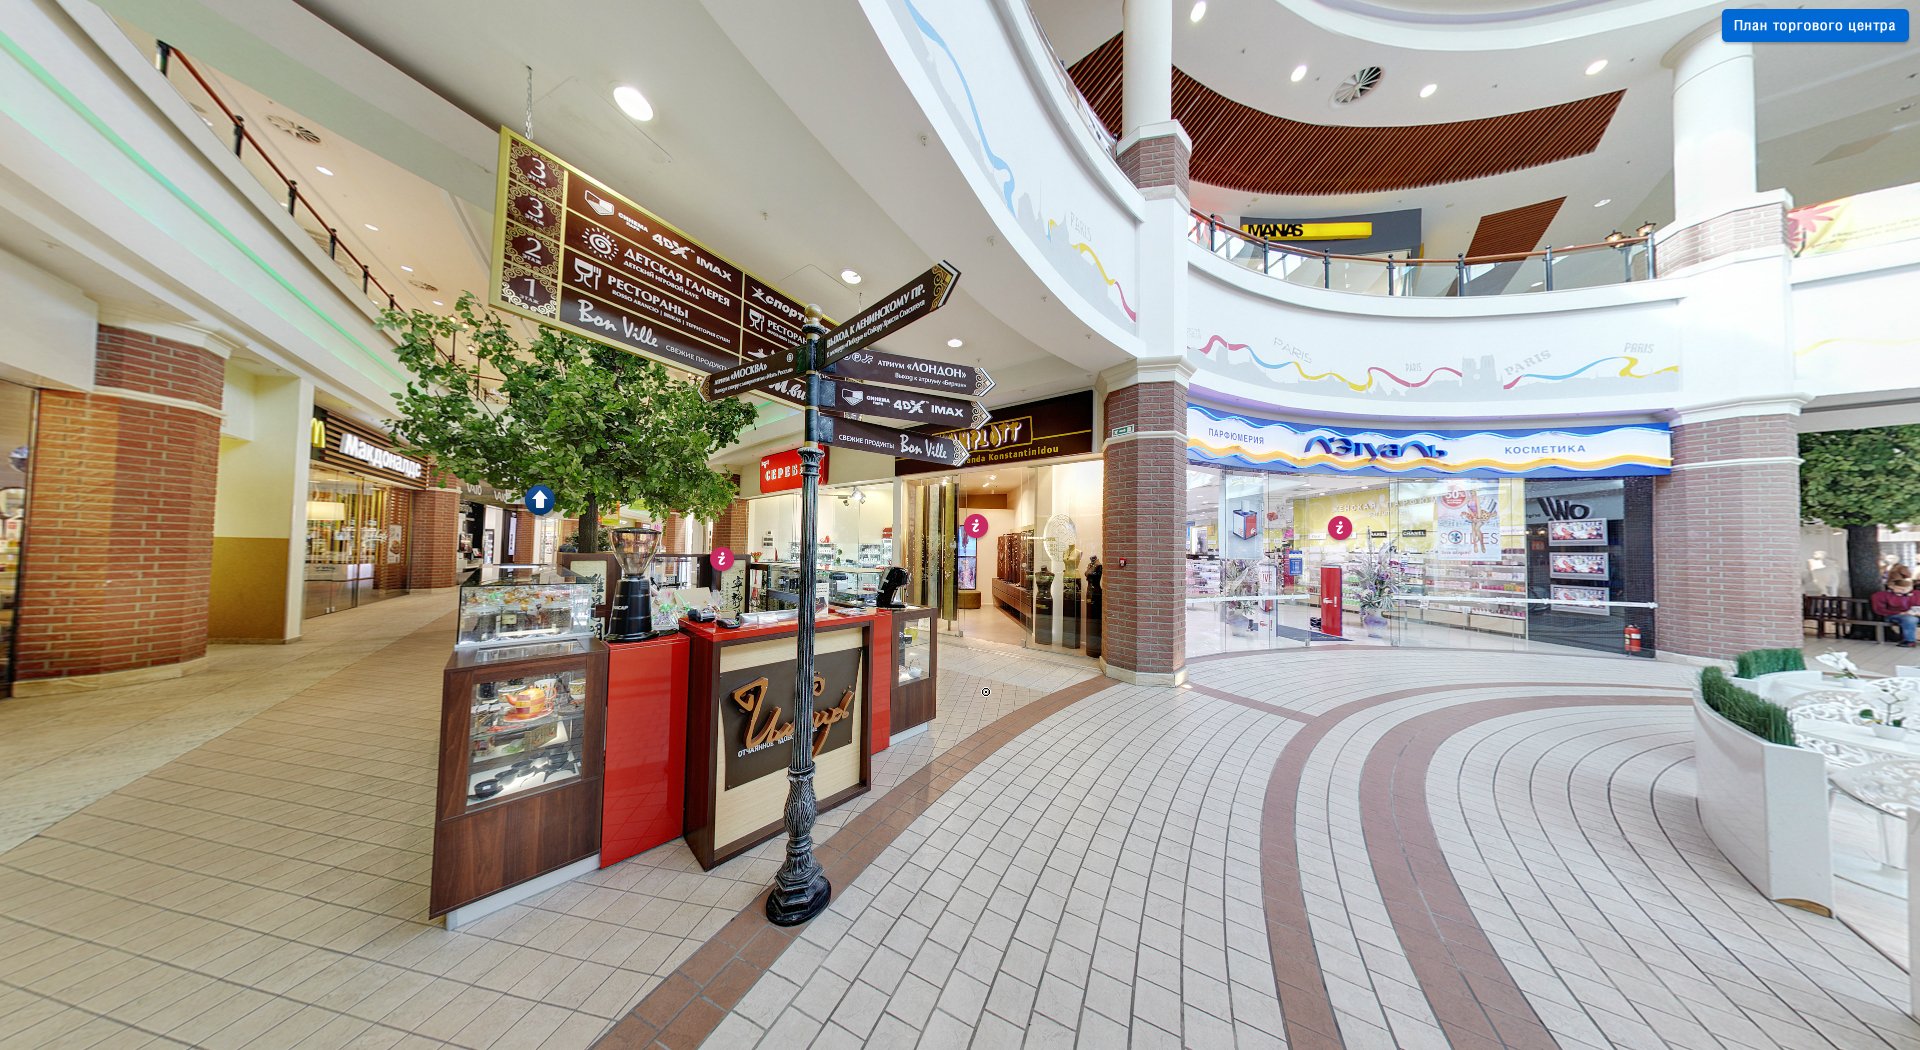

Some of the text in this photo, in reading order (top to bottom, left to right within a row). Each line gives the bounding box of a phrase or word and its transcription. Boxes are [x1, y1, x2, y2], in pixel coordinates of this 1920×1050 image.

[530, 157, 546, 179] 3
[527, 173, 547, 188] ЭТАЖ
[527, 197, 544, 219] 3
[524, 213, 545, 227] ЭТАЖ
[1248, 223, 1304, 238] MANAS
[524, 237, 542, 260] 2
[522, 253, 542, 266] ЭТАЖ
[696, 255, 732, 283] IMAX
[624, 248, 731, 307] ДЕТСКАЯ ГАЛЕРЕЯ
[524, 278, 536, 298] 1
[607, 274, 689, 319] РЕСТОРАНЫ
[855, 291, 910, 333] ЛЕНИНСКОМУ
[910, 283, 926, 300] ПР.
[577, 299, 659, 348] Bon Ville
[767, 319, 808, 345] РЕСТОРАН
[665, 344, 695, 360] СВЕЖИЕ
[1623, 342, 1655, 354] PARIS
[877, 360, 967, 379] АТРИУМ «ЛОНДОН»
[1504, 349, 1552, 376] PARIS
[931, 404, 964, 418] IMAX
[838, 434, 895, 450] СВЕЖИЕ ПРОДУКТЫ
[1208, 427, 1265, 445] ПАРФЮМЕРИЯ
[339, 433, 422, 478] Макдоналдс
[900, 433, 947, 459] Bon Ville
[988, 446, 1059, 462] Konstantinidou
[1504, 444, 1586, 455] КОСМЕТИКА
[765, 463, 803, 482] СЕРЕБ
